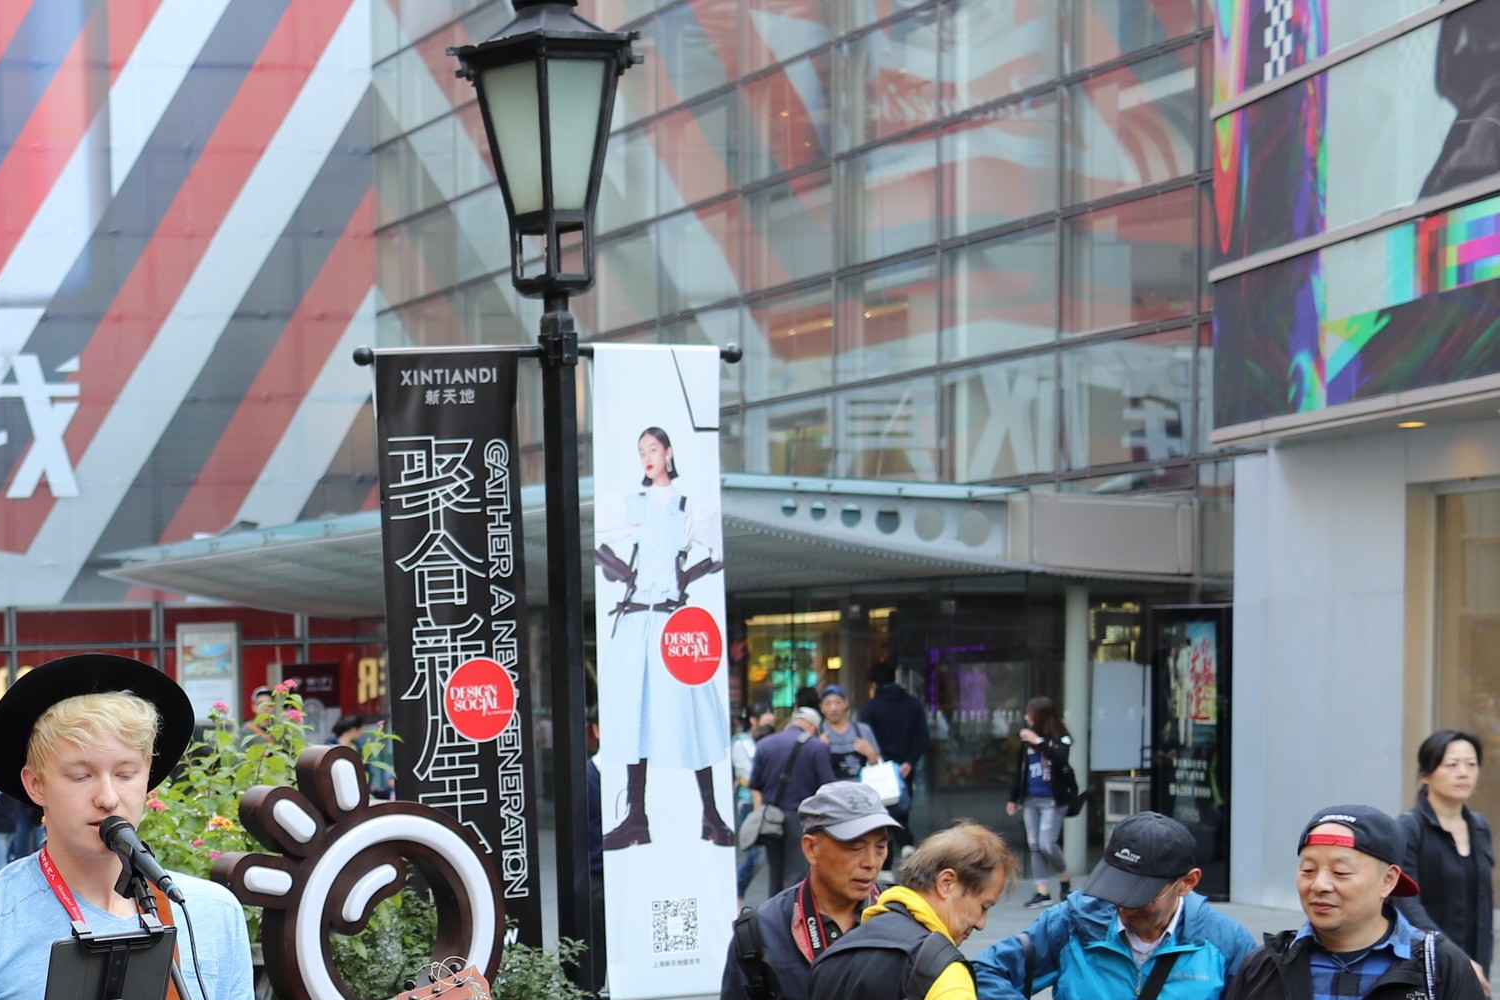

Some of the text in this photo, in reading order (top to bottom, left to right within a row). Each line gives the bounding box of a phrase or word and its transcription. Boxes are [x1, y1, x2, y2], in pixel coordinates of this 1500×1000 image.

[400, 367, 498, 387] XINTIANDI
[425, 388, 476, 405] 新天地
[484, 438, 514, 579] GATHER
[489, 584, 516, 616] A
[665, 631, 709, 646] DESIGN
[449, 684, 498, 700] DESIGN
[807, 916, 821, 949] Canon
